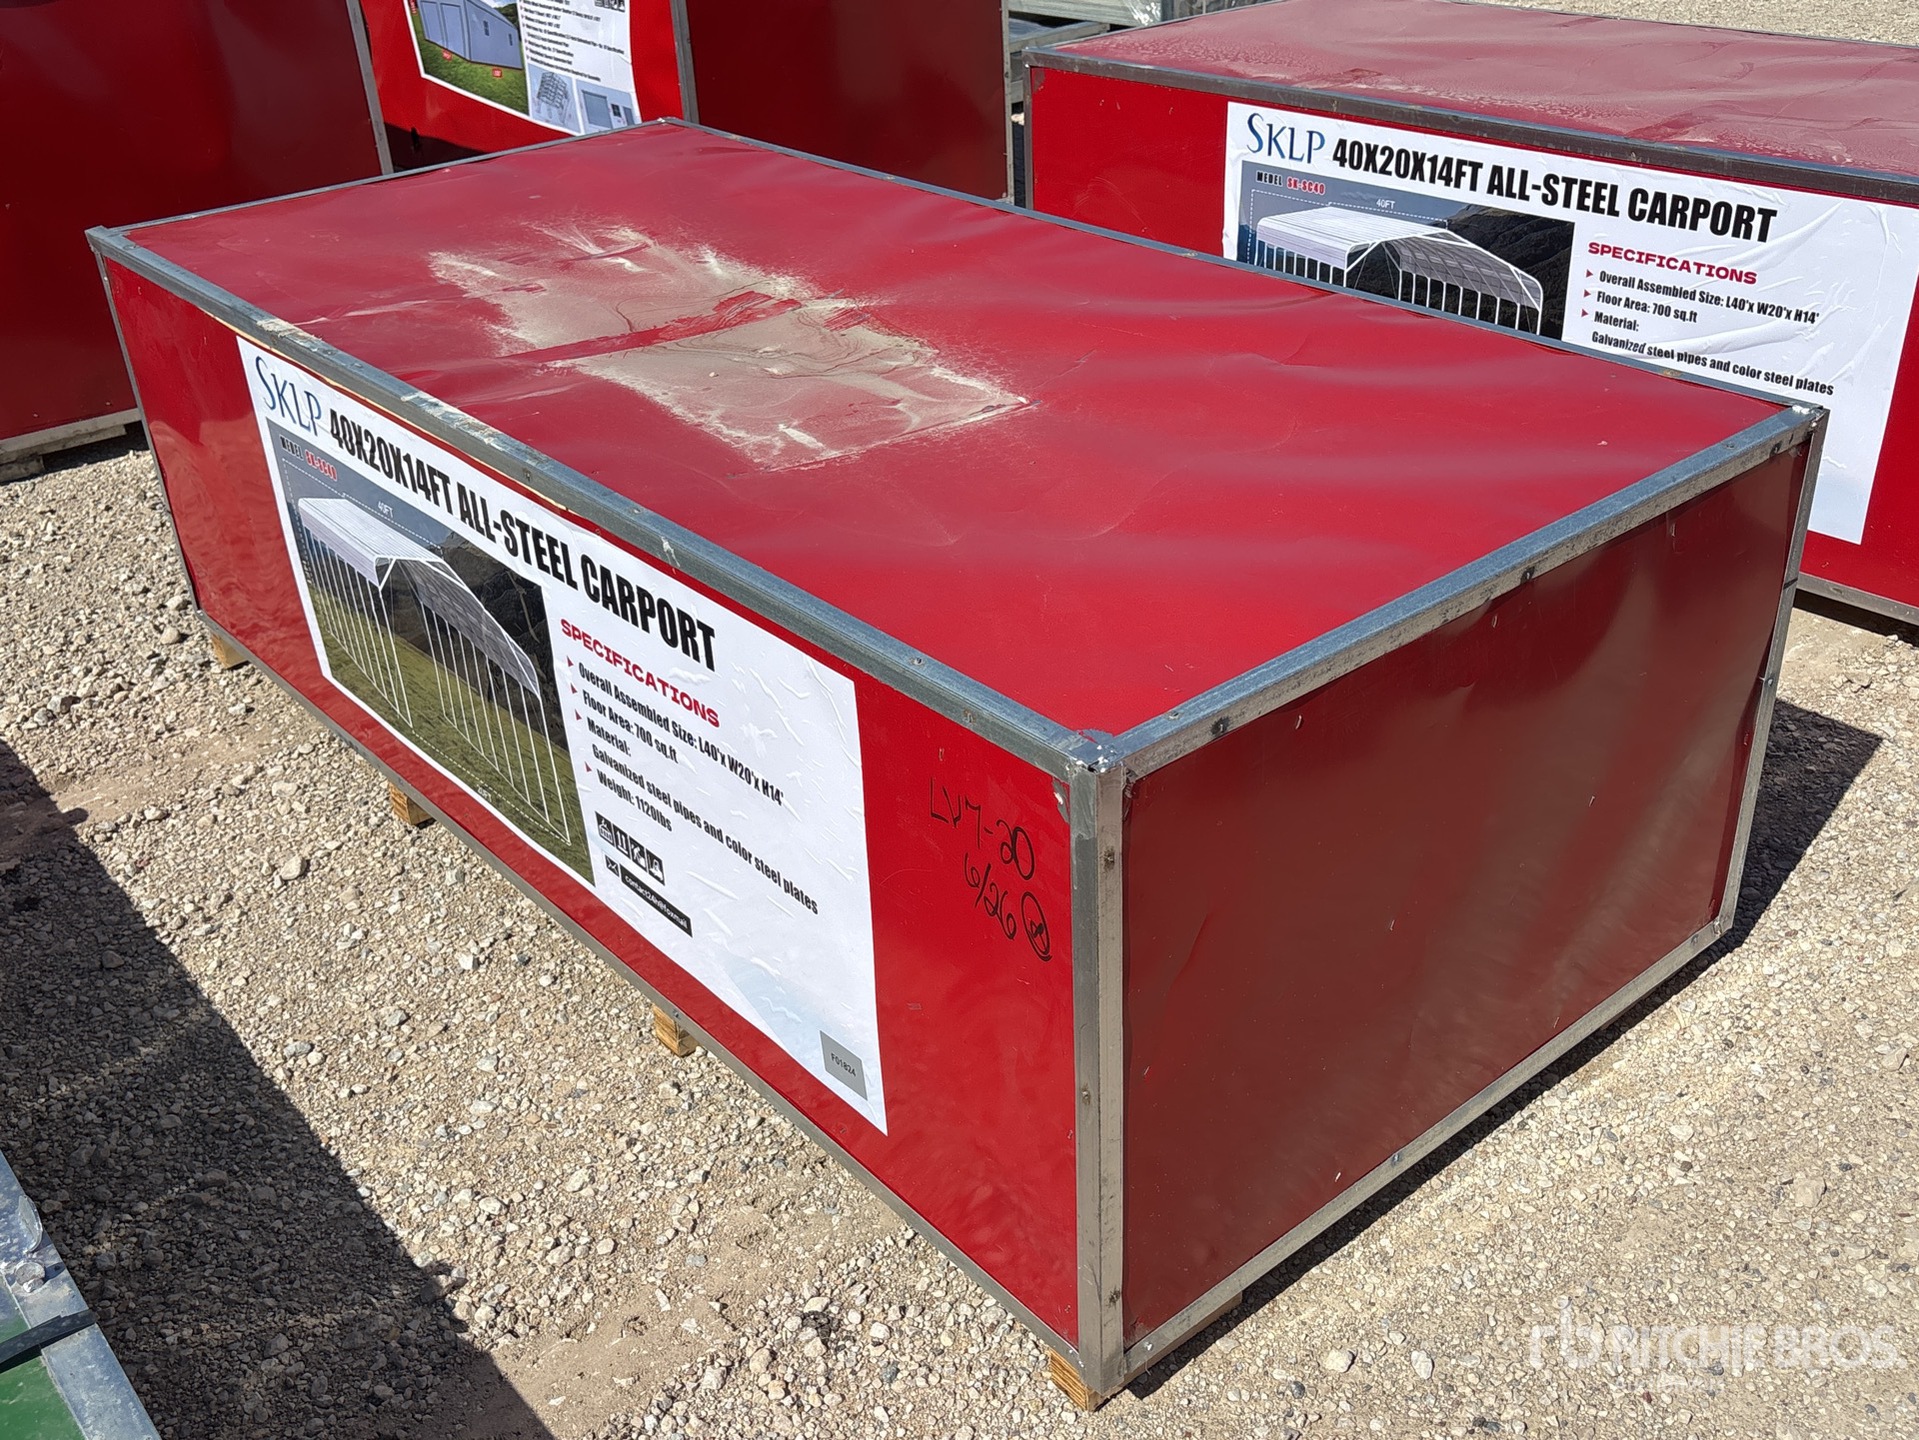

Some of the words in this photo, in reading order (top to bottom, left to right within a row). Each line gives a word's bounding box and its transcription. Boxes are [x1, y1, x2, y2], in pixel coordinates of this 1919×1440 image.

[1246, 112, 1326, 164] SKLP
[1286, 176, 1326, 195] SK-SC40
[1332, 138, 1484, 193] 40X20X14FT
[1486, 165, 1621, 217] ALL-STEEL
[1627, 188, 1778, 243] CARPORT
[1376, 199, 1396, 210] 40FT
[1588, 241, 1757, 285] SPECIFICATIONS
[1599, 270, 1635, 289] Overall
[1637, 278, 1696, 302] Assembled
[1698, 291, 1724, 307] Size:
[1594, 311, 1639, 332] Material:
[1597, 291, 1622, 307] Floor
[1624, 298, 1650, 314] Area:
[1652, 303, 1671, 318] 700
[1673, 309, 1698, 324] sq.ft
[1592, 331, 1645, 354] Galvanized
[1646, 346, 1675, 360] steel
[1677, 351, 1707, 367] pipes
[1709, 359, 1730, 373] and
[1732, 363, 1762, 380] color
[1764, 371, 1793, 388] steel
[1795, 378, 1834, 396] plates
[255, 355, 322, 437] SKLP
[330, 407, 452, 516] 40X20X14FT
[456, 481, 578, 590] ALL-STEEL
[580, 553, 716, 674] CARPORT
[560, 618, 720, 728] SPECIFICATIONS
[578, 662, 612, 697] Overall
[613, 684, 670, 733] Assembled
[671, 720, 698, 749] Size:
[582, 689, 606, 715] Floor
[608, 706, 635, 735] Area:
[634, 722, 653, 747] 700
[654, 738, 678, 763] sq.ft
[587, 717, 631, 757] Material:
[592, 743, 645, 790] Galvanized
[646, 781, 671, 808] steel
[673, 798, 702, 829] pipes
[703, 820, 724, 844] and
[725, 835, 752, 864] color
[754, 856, 782, 887] steel
[783, 878, 819, 915] plates
[597, 768, 635, 806] Weight:
[635, 795, 672, 832] 1120lbs
